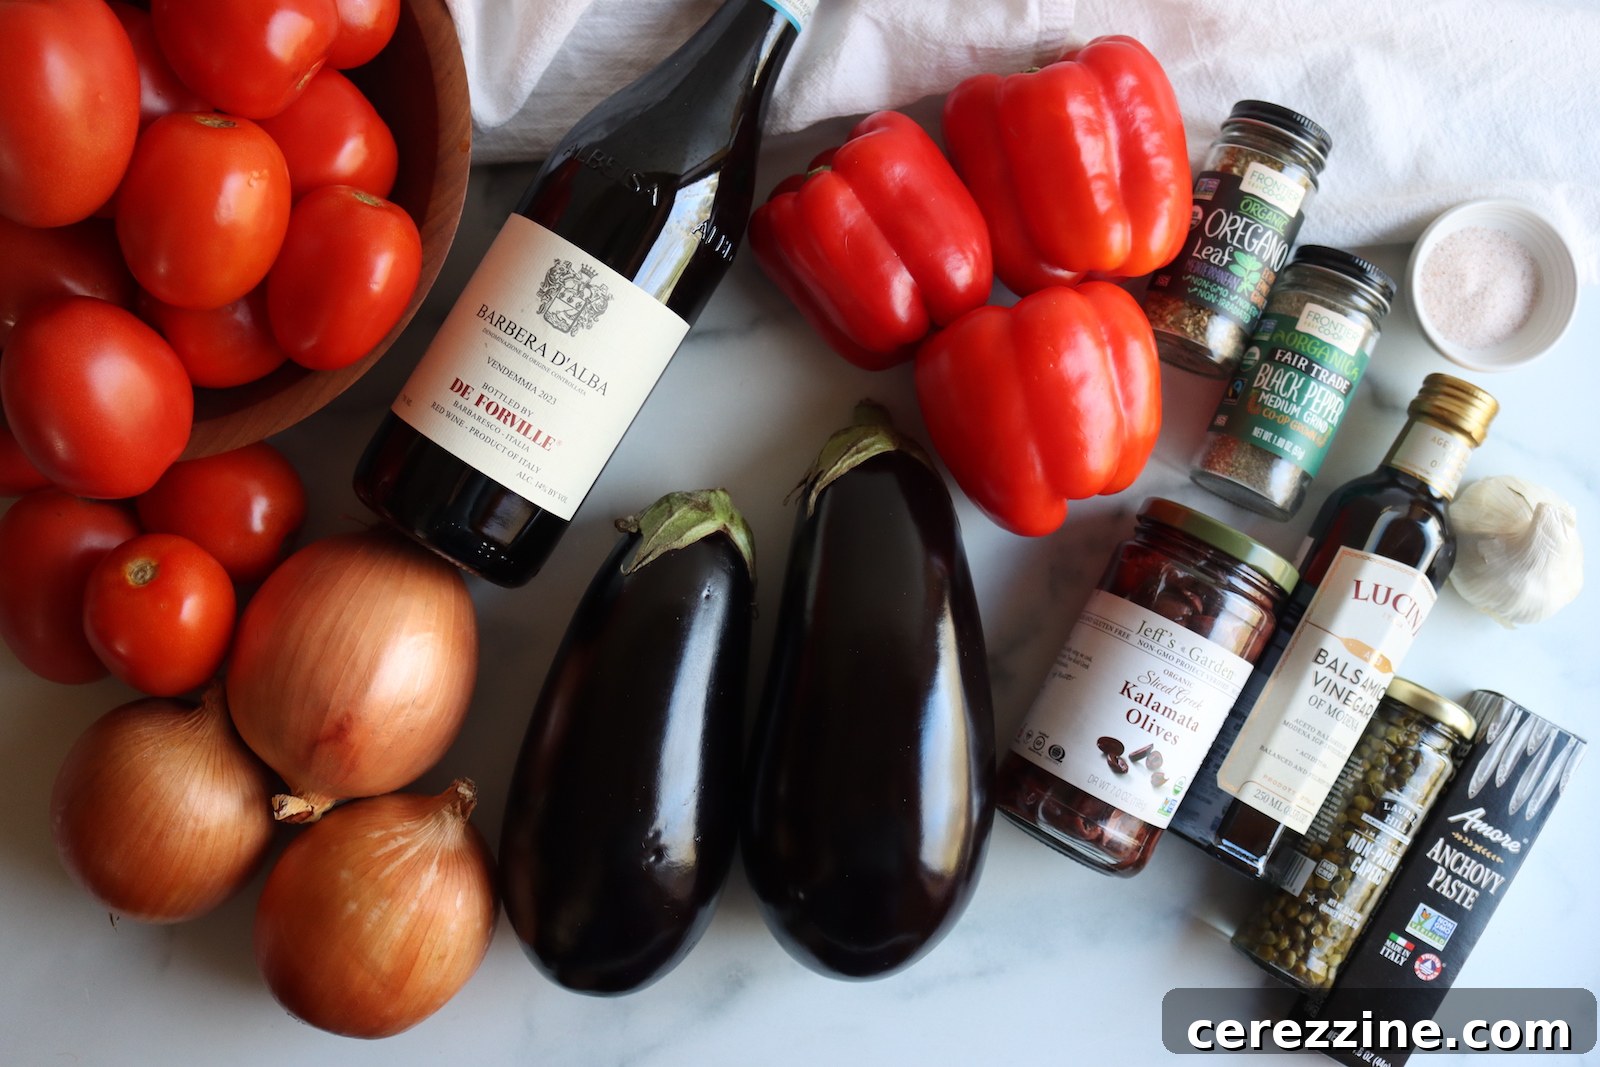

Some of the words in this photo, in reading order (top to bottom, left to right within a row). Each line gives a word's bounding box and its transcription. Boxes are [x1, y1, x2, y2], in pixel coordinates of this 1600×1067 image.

[1240, 199, 1288, 231] ORGANIC
[1192, 238, 1233, 266] Leaf
[1204, 208, 1288, 272] OREGANO
[1191, 277, 1229, 297] NON-GMO
[1305, 309, 1361, 342] FRONTIER
[476, 304, 547, 358] BARBERA
[551, 350, 609, 397] D'ALBA
[482, 327, 523, 355] DENOMINAZIONE
[529, 357, 550, 374] ORIGINE
[551, 370, 586, 397] CONTROLLATA
[1284, 330, 1354, 374] ORGANIC
[487, 356, 537, 394] VENDEMMIA
[538, 390, 557, 406] 2023
[1274, 349, 1309, 371] FAIR
[1310, 363, 1351, 394] TRADE
[481, 382, 520, 410] BOTTLED
[520, 406, 534, 418] BY
[1253, 363, 1304, 402] BLACK
[1301, 379, 1345, 427] PEPPER
[449, 377, 475, 401] DE
[474, 393, 557, 452] FORVILLE
[452, 400, 501, 434] BARBARESCO
[505, 434, 530, 453] ITALIA
[1258, 391, 1300, 419] MEDIUM
[1303, 411, 1330, 433] GRIND
[1262, 408, 1290, 424] CO-OP
[431, 401, 445, 415] RED
[445, 411, 464, 428] WINE
[469, 426, 507, 454] PRODUCT
[507, 450, 520, 461] OF
[518, 457, 542, 474] ITALY
[1252, 426, 1264, 438] NET
[1114, 627, 1131, 640] FREE
[1137, 639, 1175, 662] NON-GMO
[1175, 658, 1205, 677] PROJECT
[1136, 619, 1176, 649] Jeff's
[1188, 646, 1234, 681] Garden
[1137, 669, 1177, 695] Sliced
[1172, 687, 1204, 712] Greek
[1163, 668, 1195, 688] ORGANIC
[1118, 679, 1200, 733] Kalamata
[1312, 671, 1374, 719] VINEGAR
[1125, 707, 1180, 746] Olives
[1283, 719, 1311, 739] MODENA
[1294, 718, 1316, 733] ACETO
[1307, 694, 1327, 708] OF
[1326, 702, 1359, 732] MODENA
[1259, 744, 1294, 768] BALANCED
[1293, 764, 1308, 775] AND
[1253, 788, 1271, 804] 250
[1268, 796, 1284, 813] ML
[1262, 774, 1299, 795] PRODOTT
[1384, 802, 1417, 827] LAUREL
[1384, 814, 1407, 834] HILL
[1448, 807, 1521, 853] Amore
[1317, 867, 1333, 880] GMO
[1321, 861, 1335, 873] NON
[1350, 856, 1386, 885] CAPERS
[1426, 837, 1506, 896] ANCHOVY
[1426, 865, 1480, 911] PASTE
[1409, 921, 1446, 946] VERIFIED
[1434, 921, 1451, 934] GMO
[1437, 917, 1455, 930] NON
[1379, 946, 1408, 966] ITALY
[1384, 939, 1403, 953] MADE
[1401, 948, 1412, 958] IN
[1362, 1051, 1375, 1062] OZ
